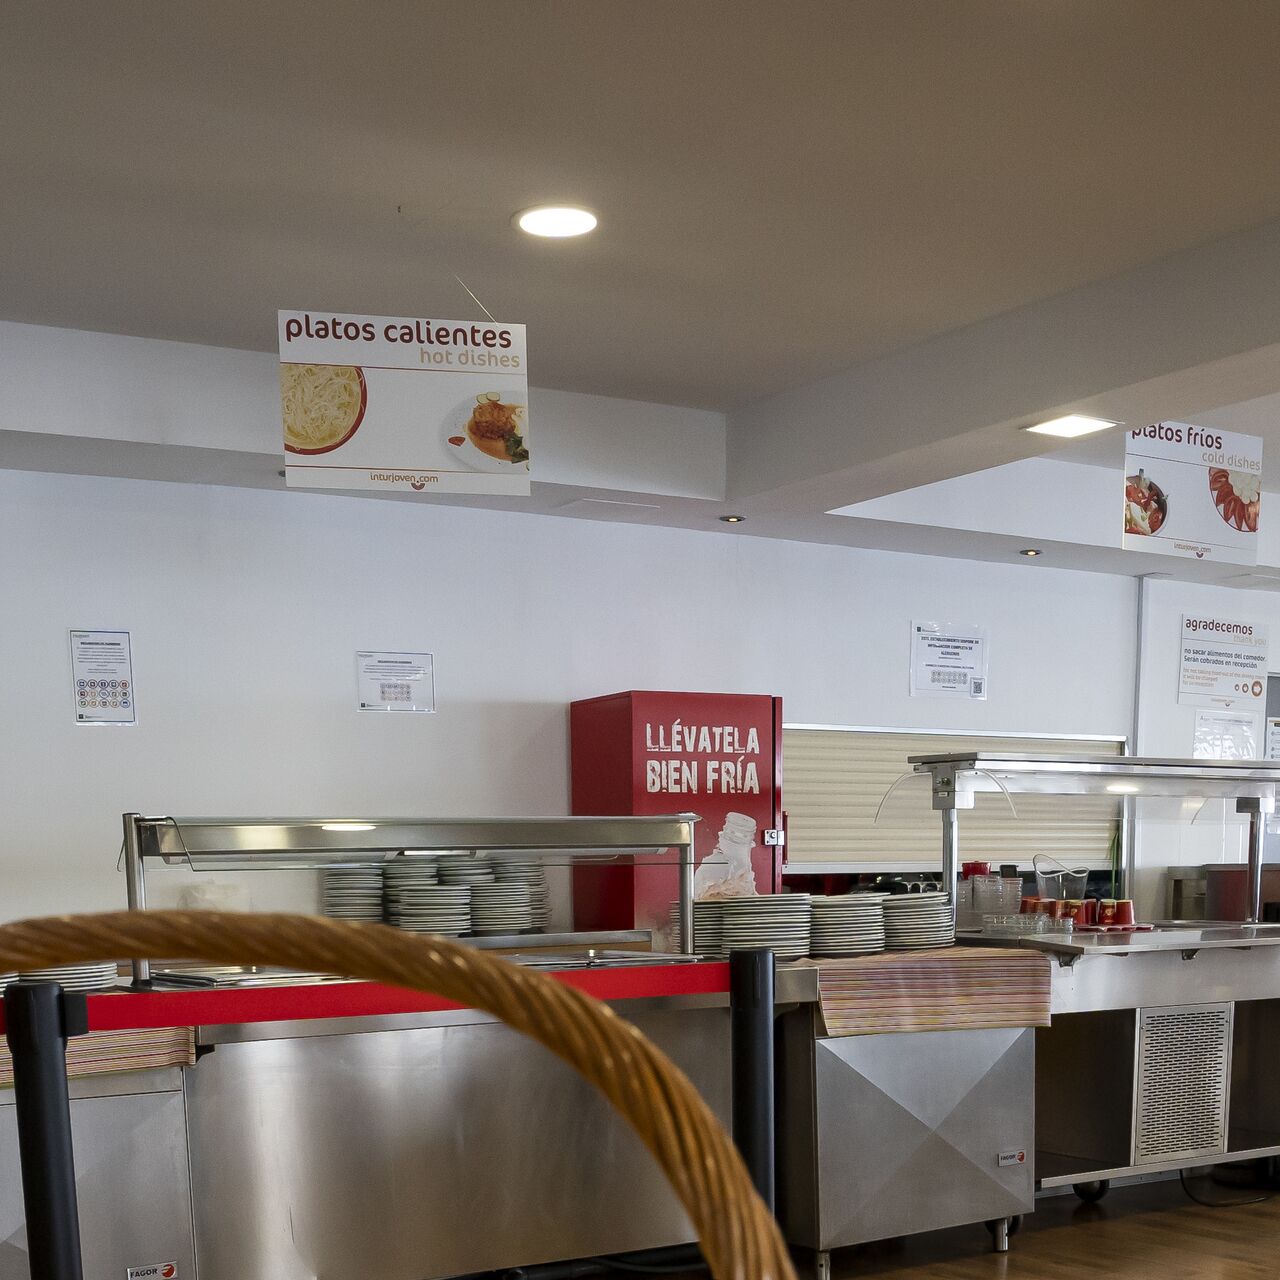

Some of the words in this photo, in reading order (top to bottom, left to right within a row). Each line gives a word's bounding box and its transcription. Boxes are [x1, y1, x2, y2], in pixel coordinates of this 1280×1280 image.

[285, 314, 376, 342] platos
[383, 320, 512, 349] calientes
[420, 348, 453, 365] hot
[458, 348, 520, 368] dishes
[1131, 423, 1182, 443] platos
[1187, 426, 1223, 450] fríos
[1201, 450, 1225, 465] cold
[1227, 453, 1261, 471] dishes
[369, 471, 439, 484] inturjoven.com
[1185, 619, 1253, 635] agradecemos
[646, 718, 760, 754] LLÉVATELA
[646, 759, 698, 794] BIEN
[706, 755, 760, 795] FRÍA
[130, 1268, 158, 1279] FAGOR
